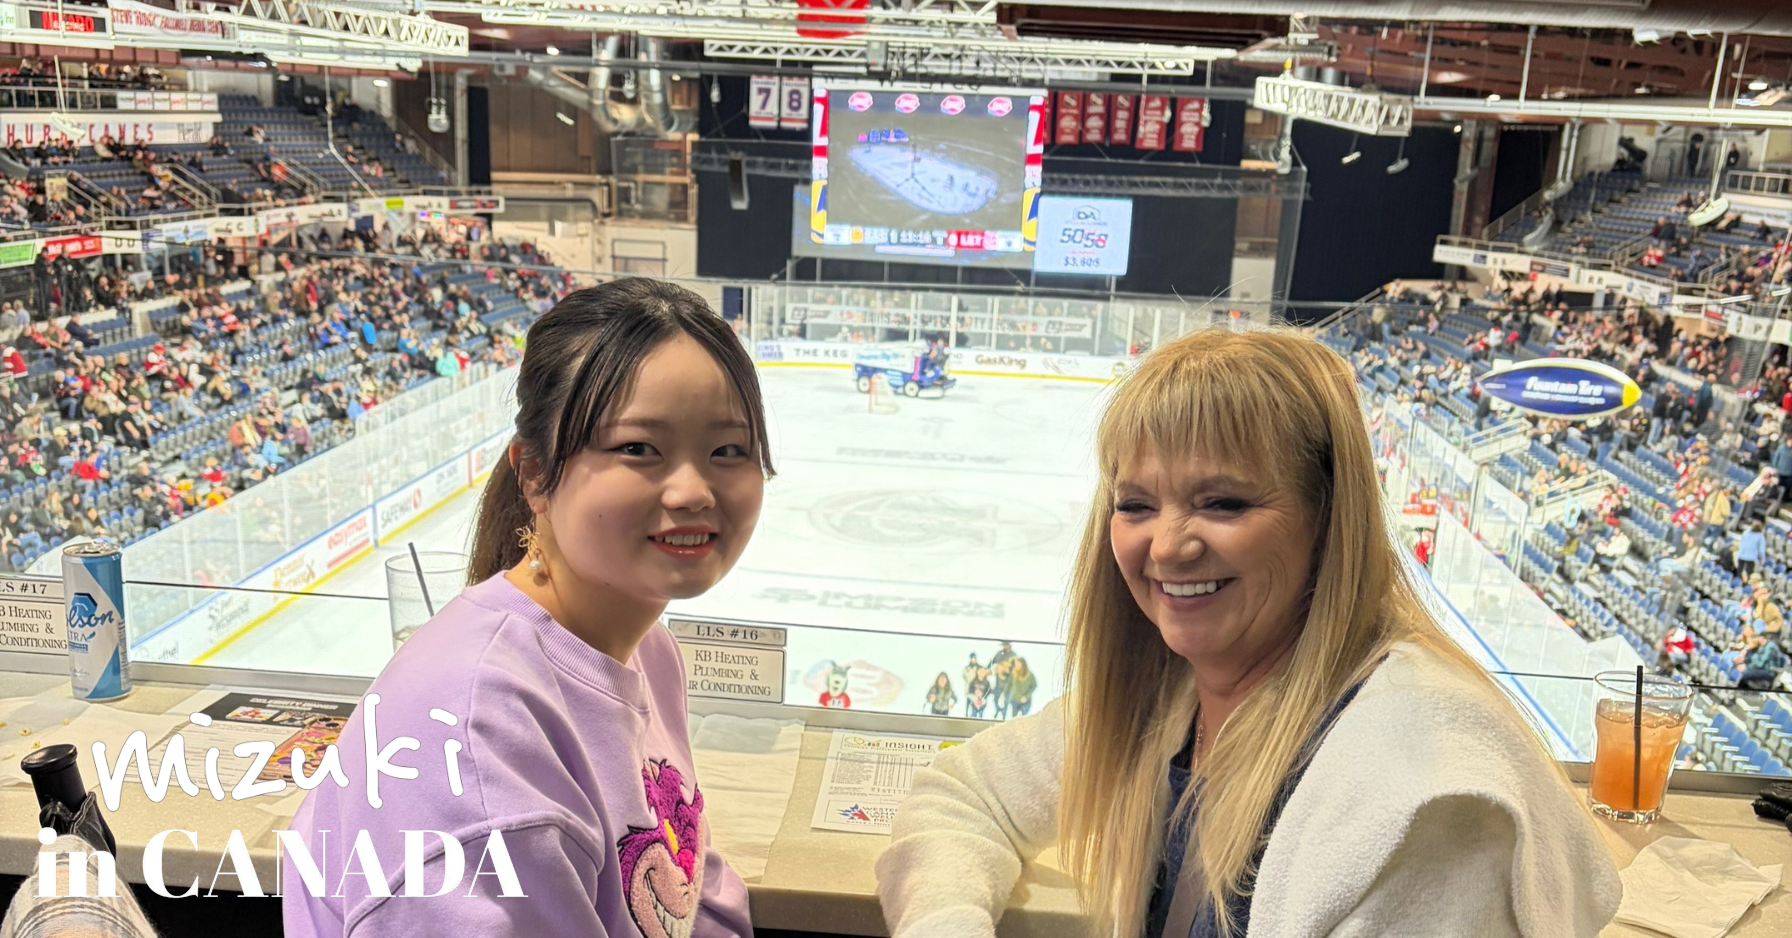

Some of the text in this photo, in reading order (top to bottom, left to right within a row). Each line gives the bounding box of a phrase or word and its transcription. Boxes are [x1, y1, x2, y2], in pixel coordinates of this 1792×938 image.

[757, 87, 771, 110] 7
[788, 89, 802, 112] 8
[6, 123, 154, 148] HURCANES
[794, 348, 818, 358] THE
[824, 348, 848, 359] KEG
[20, 582, 47, 594] #17
[45, 622, 55, 635] &
[696, 624, 758, 640] LLS #16
[694, 649, 712, 662] KB
[749, 668, 760, 681] &
